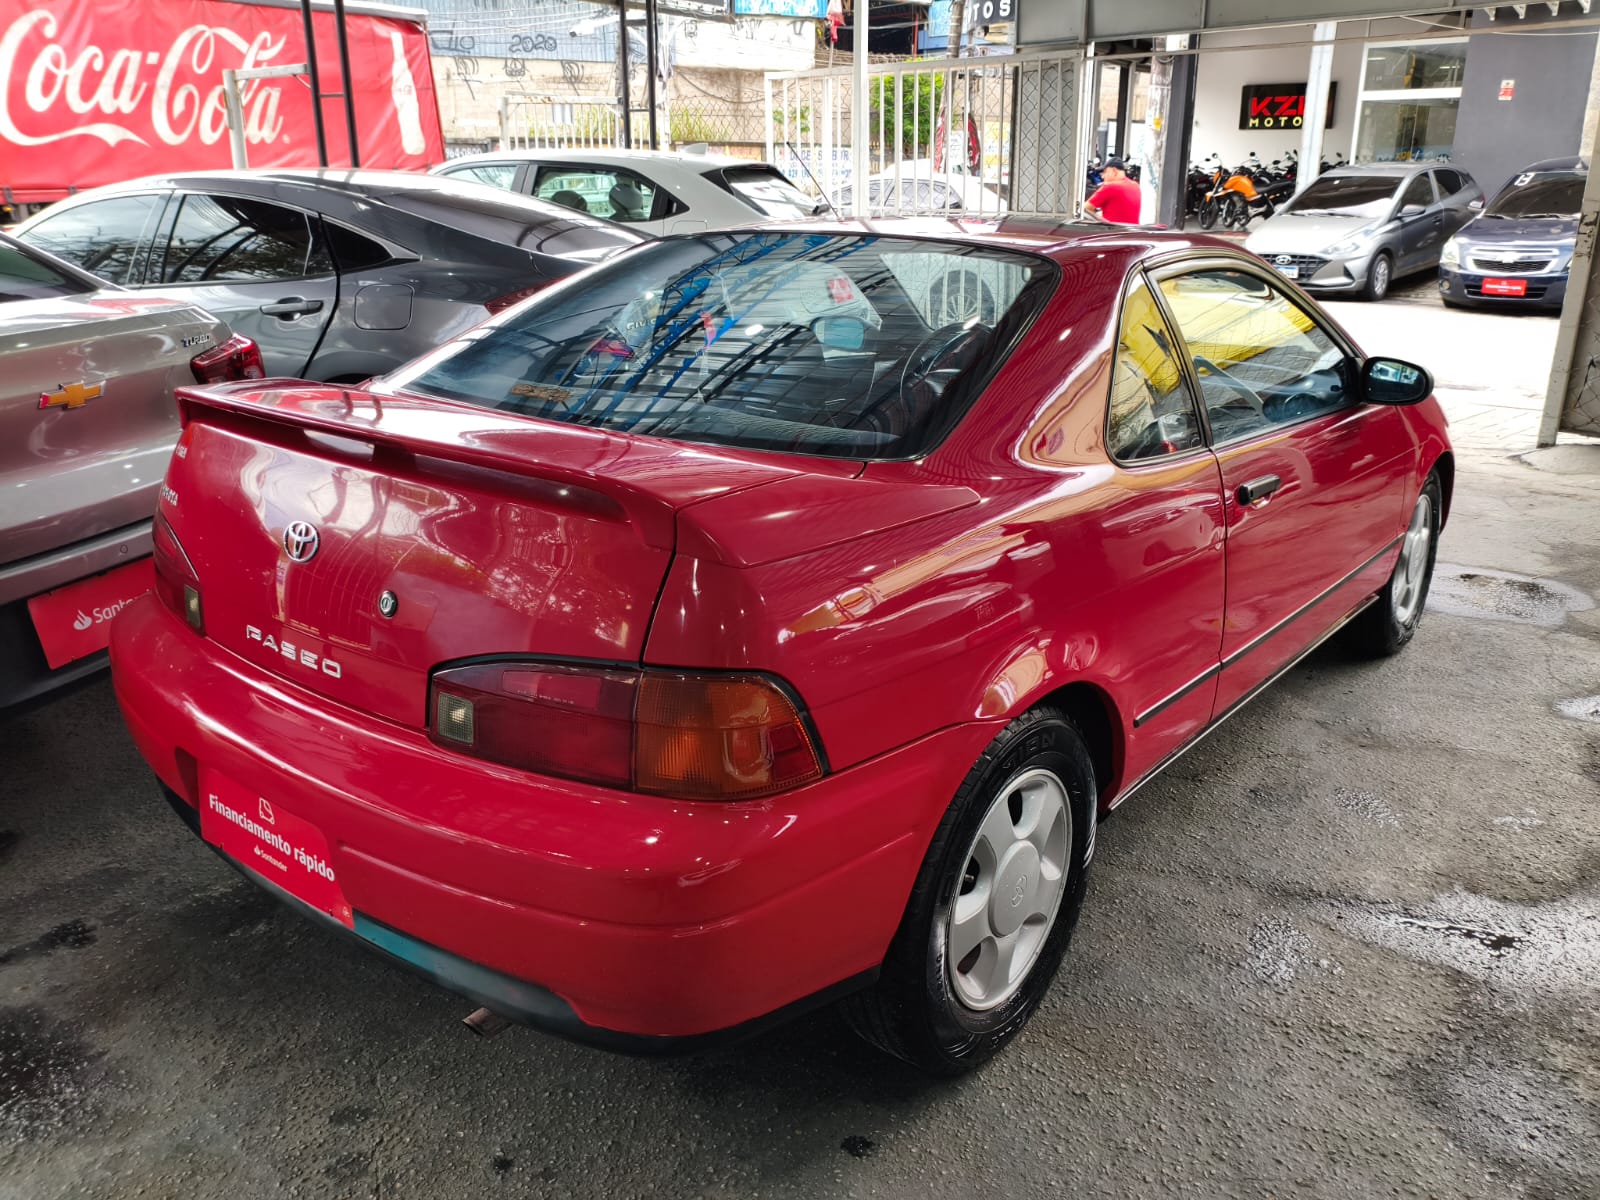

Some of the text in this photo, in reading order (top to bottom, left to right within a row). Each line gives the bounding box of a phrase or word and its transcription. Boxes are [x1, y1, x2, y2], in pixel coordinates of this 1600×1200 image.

[508, 33, 558, 53] 2020
[0, 9, 288, 147] Coca-Cola
[1248, 116, 1303, 128] MOTO
[245, 624, 343, 679] PASEO
[208, 793, 336, 882] Financiamento rápido
